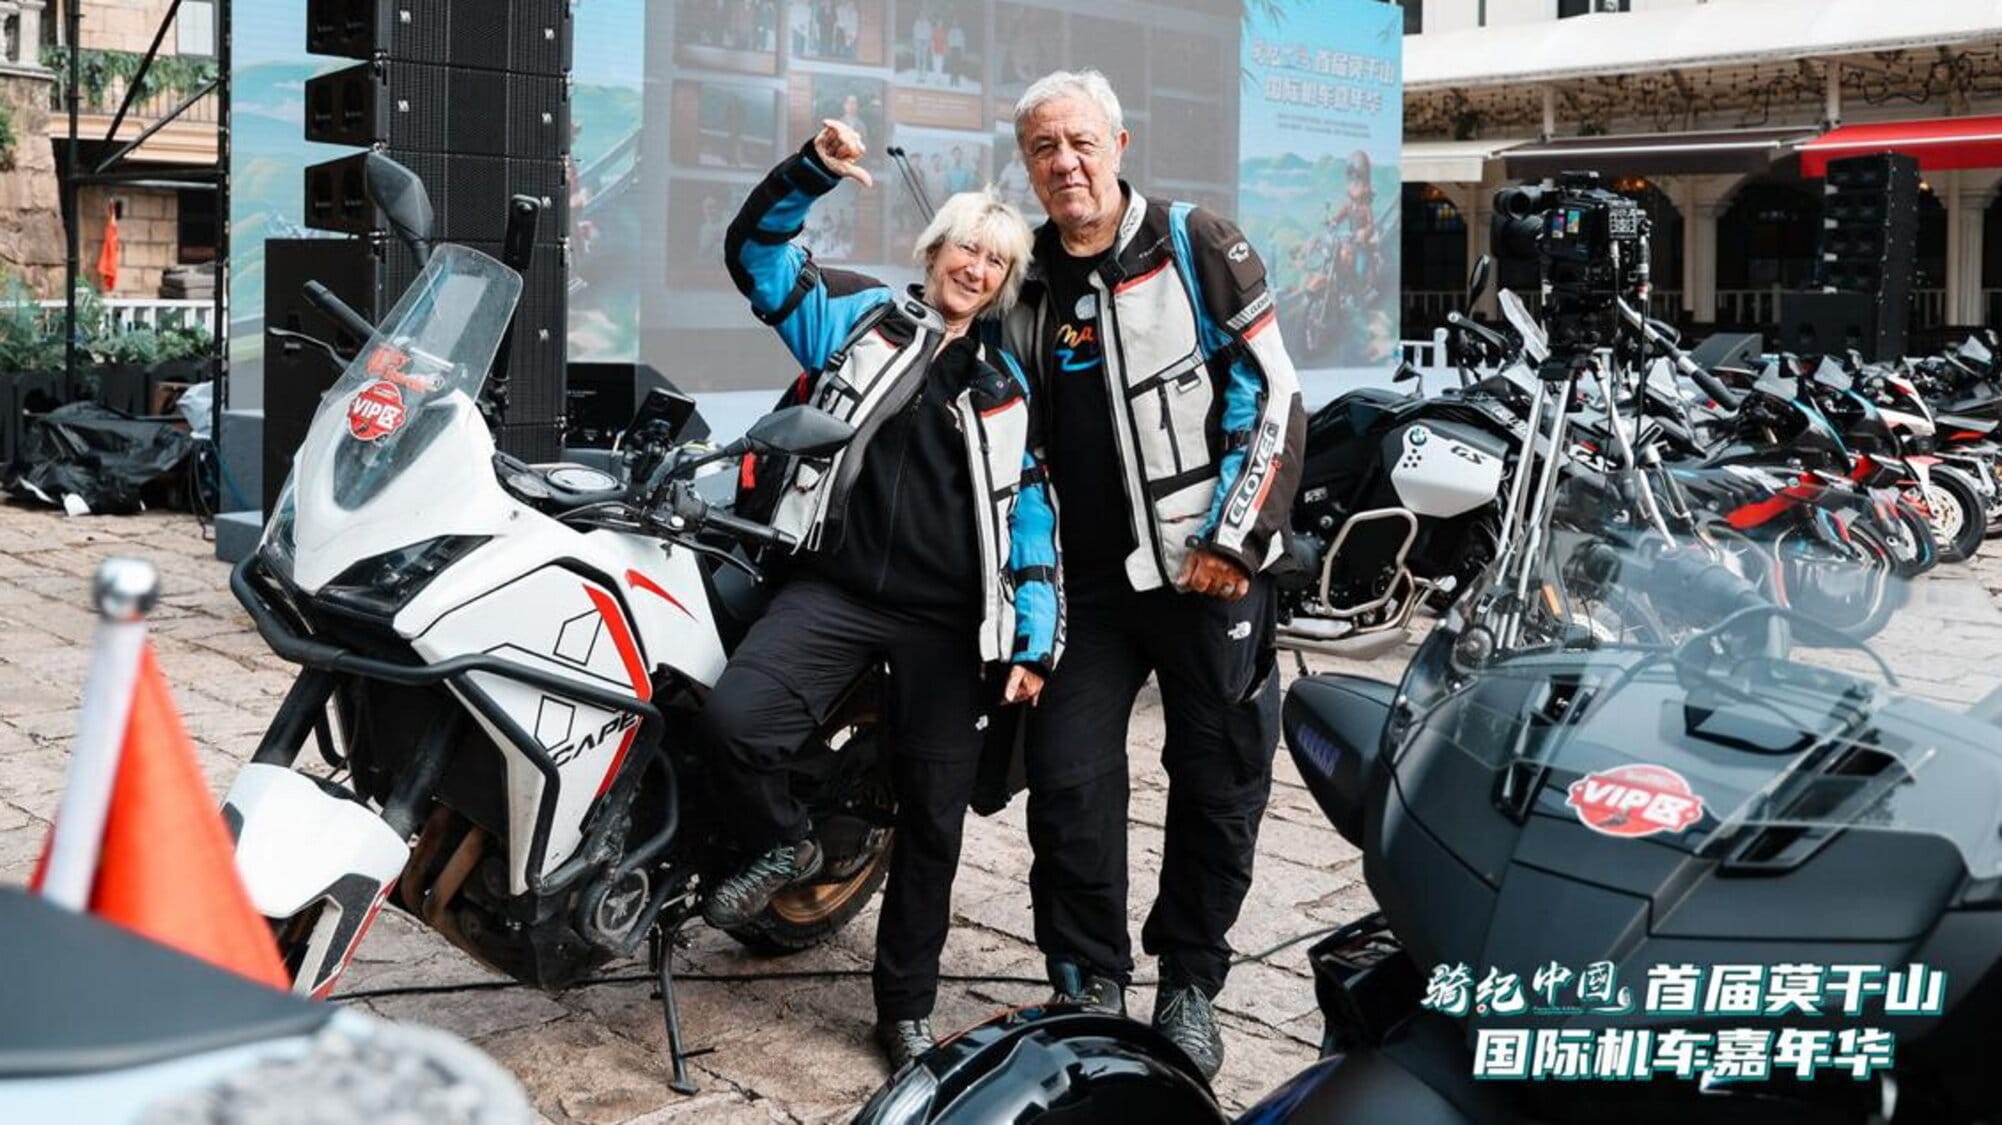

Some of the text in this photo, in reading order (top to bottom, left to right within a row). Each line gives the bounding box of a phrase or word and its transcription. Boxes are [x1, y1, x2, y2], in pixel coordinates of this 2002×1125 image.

[352, 397, 402, 430] VIP区
[1228, 421, 1280, 526] CLOVER
[1583, 780, 1694, 826] VIP区
